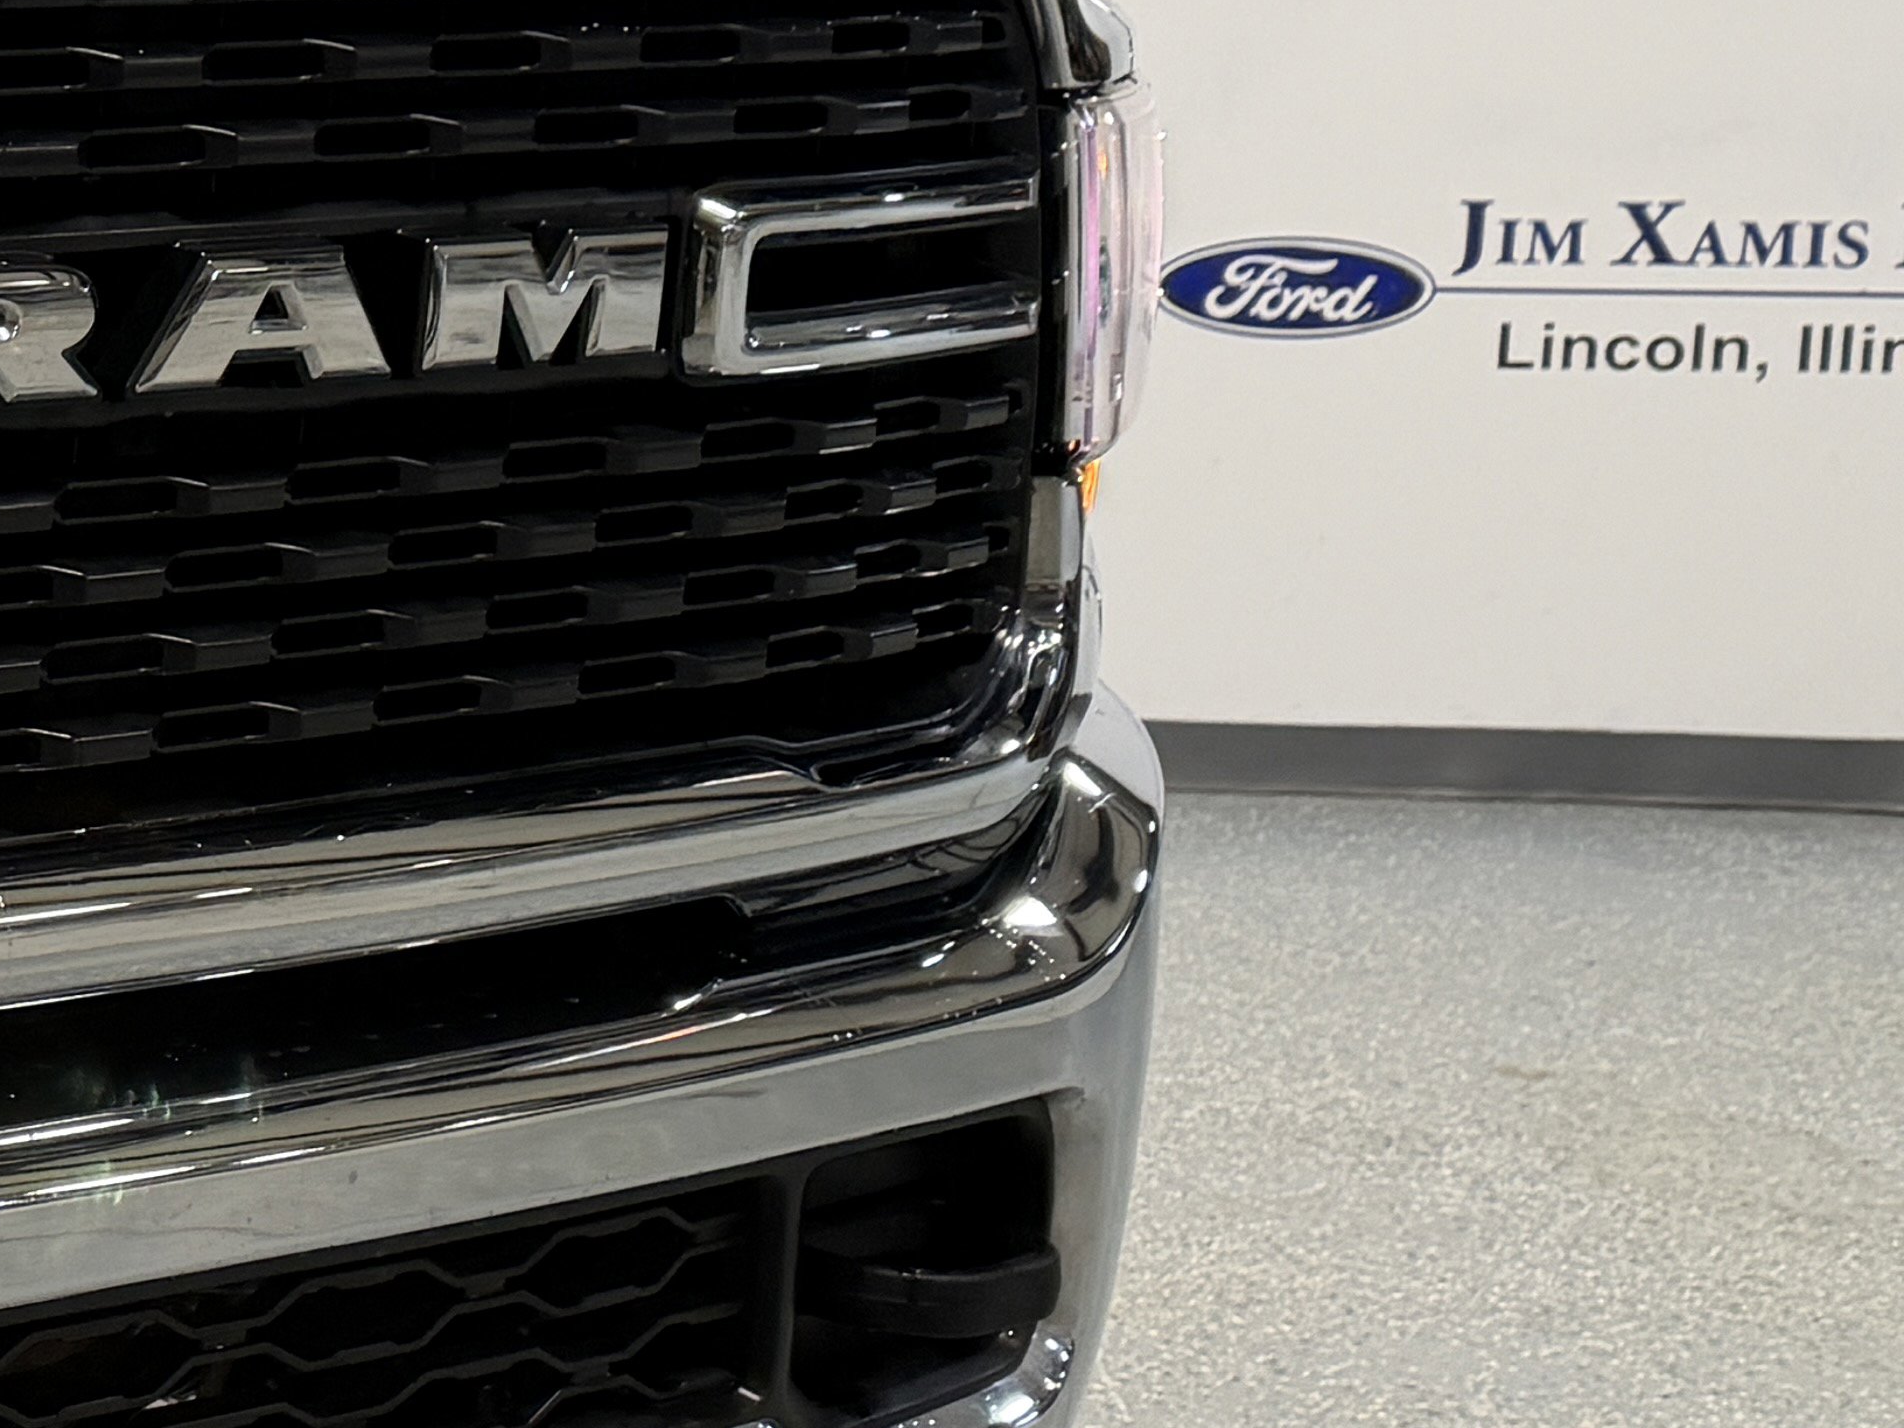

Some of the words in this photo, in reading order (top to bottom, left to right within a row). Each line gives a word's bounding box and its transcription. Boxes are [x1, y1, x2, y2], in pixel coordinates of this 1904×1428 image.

[1451, 200, 1584, 276] JIM
[1610, 201, 1869, 269] XAMIS
[1497, 322, 1768, 383] Lincoln,
